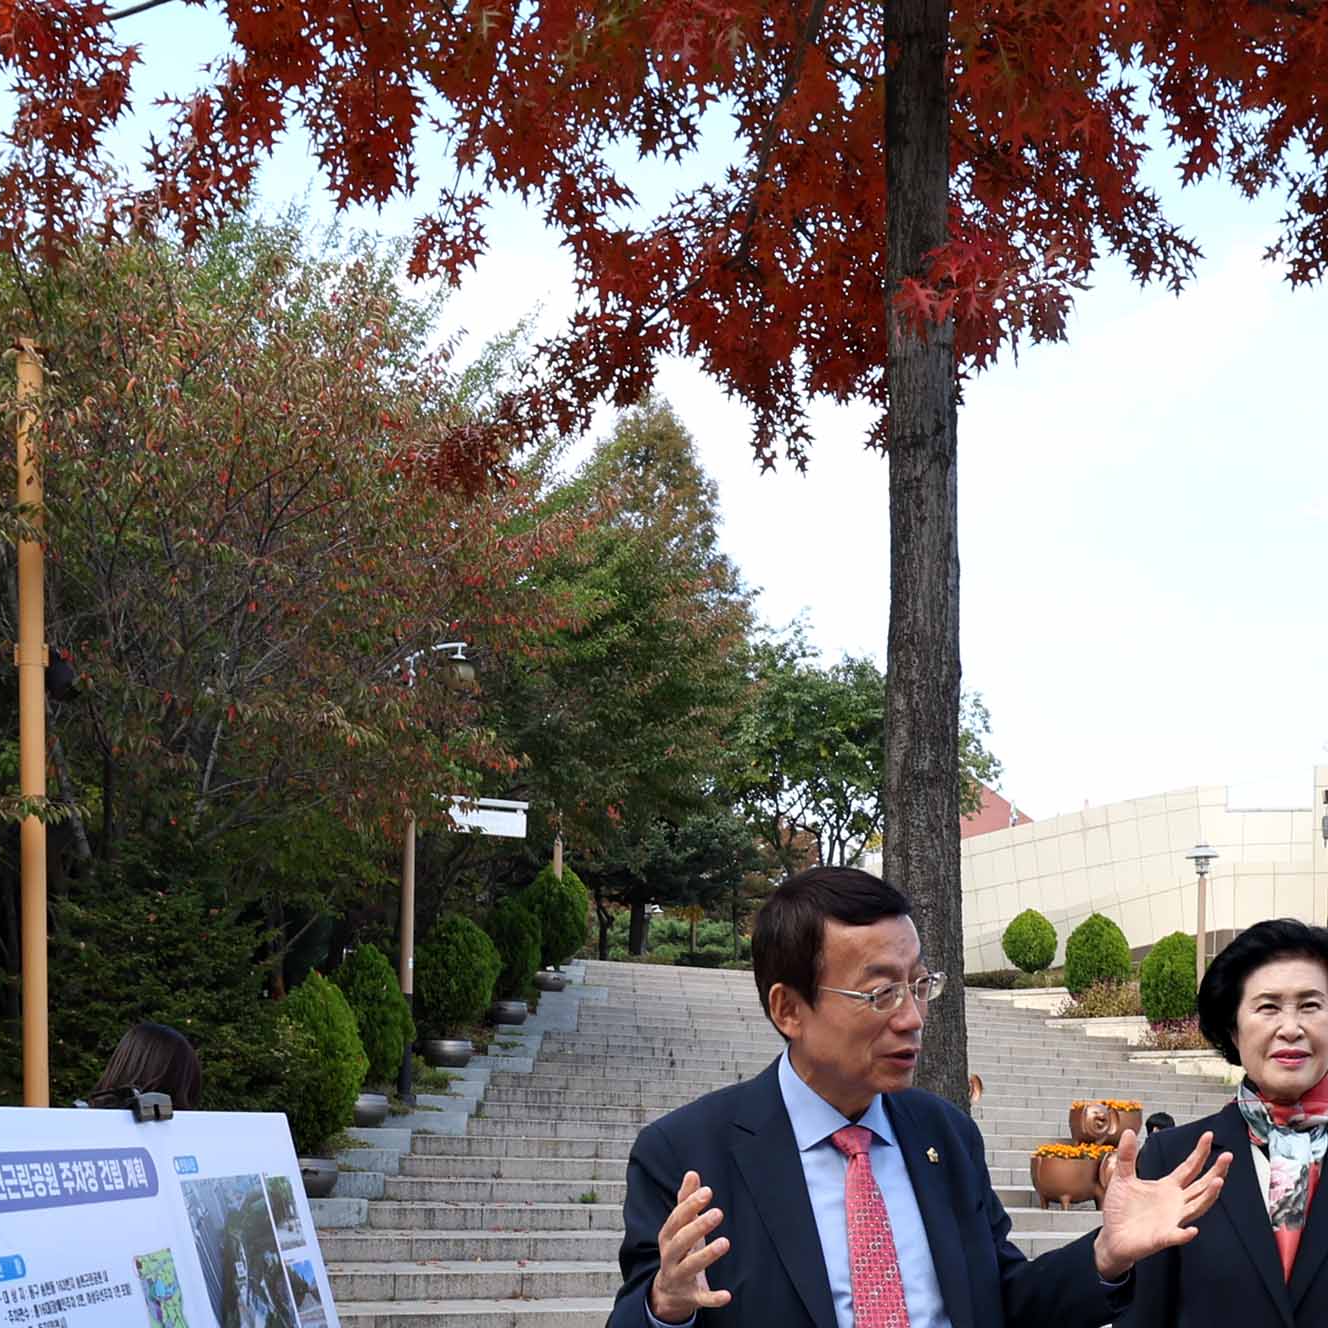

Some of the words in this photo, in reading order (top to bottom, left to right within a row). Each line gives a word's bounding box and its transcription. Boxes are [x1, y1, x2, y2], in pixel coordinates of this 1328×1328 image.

[59, 1160, 98, 1194] 주차장
[98, 1160, 125, 1191] 건립
[123, 1157, 149, 1188] 계획
